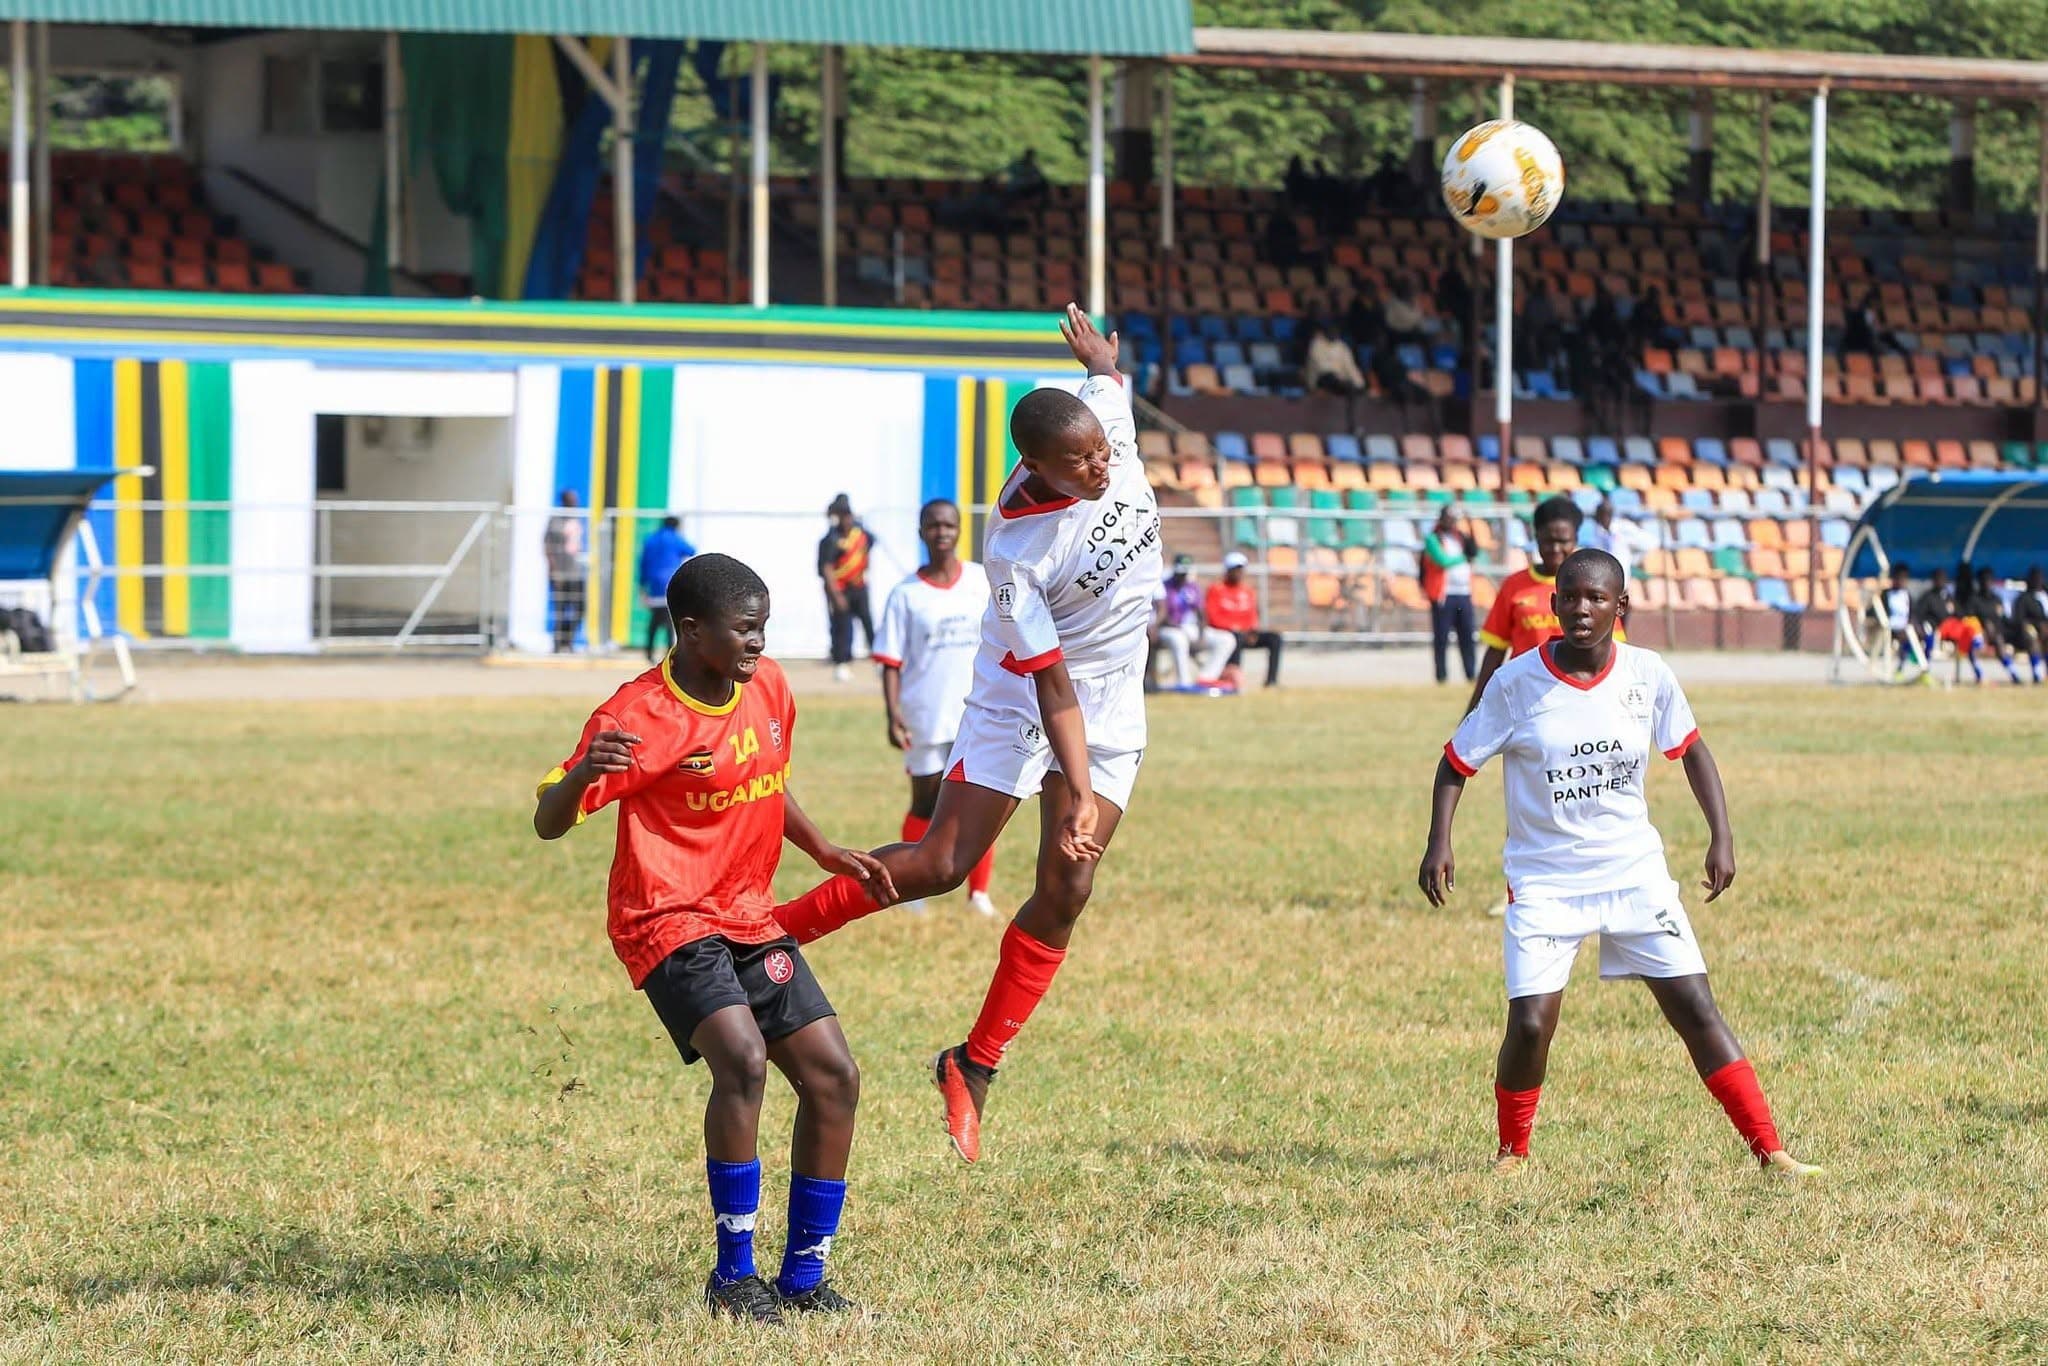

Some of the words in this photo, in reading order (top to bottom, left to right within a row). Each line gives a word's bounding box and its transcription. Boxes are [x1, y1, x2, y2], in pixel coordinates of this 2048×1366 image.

[1087, 501, 1130, 554] JOGA
[728, 726, 760, 765] 14
[1570, 740, 1623, 757] JOGA
[685, 770, 784, 812] UGANDA
[1553, 771, 1633, 804] PANTHER
